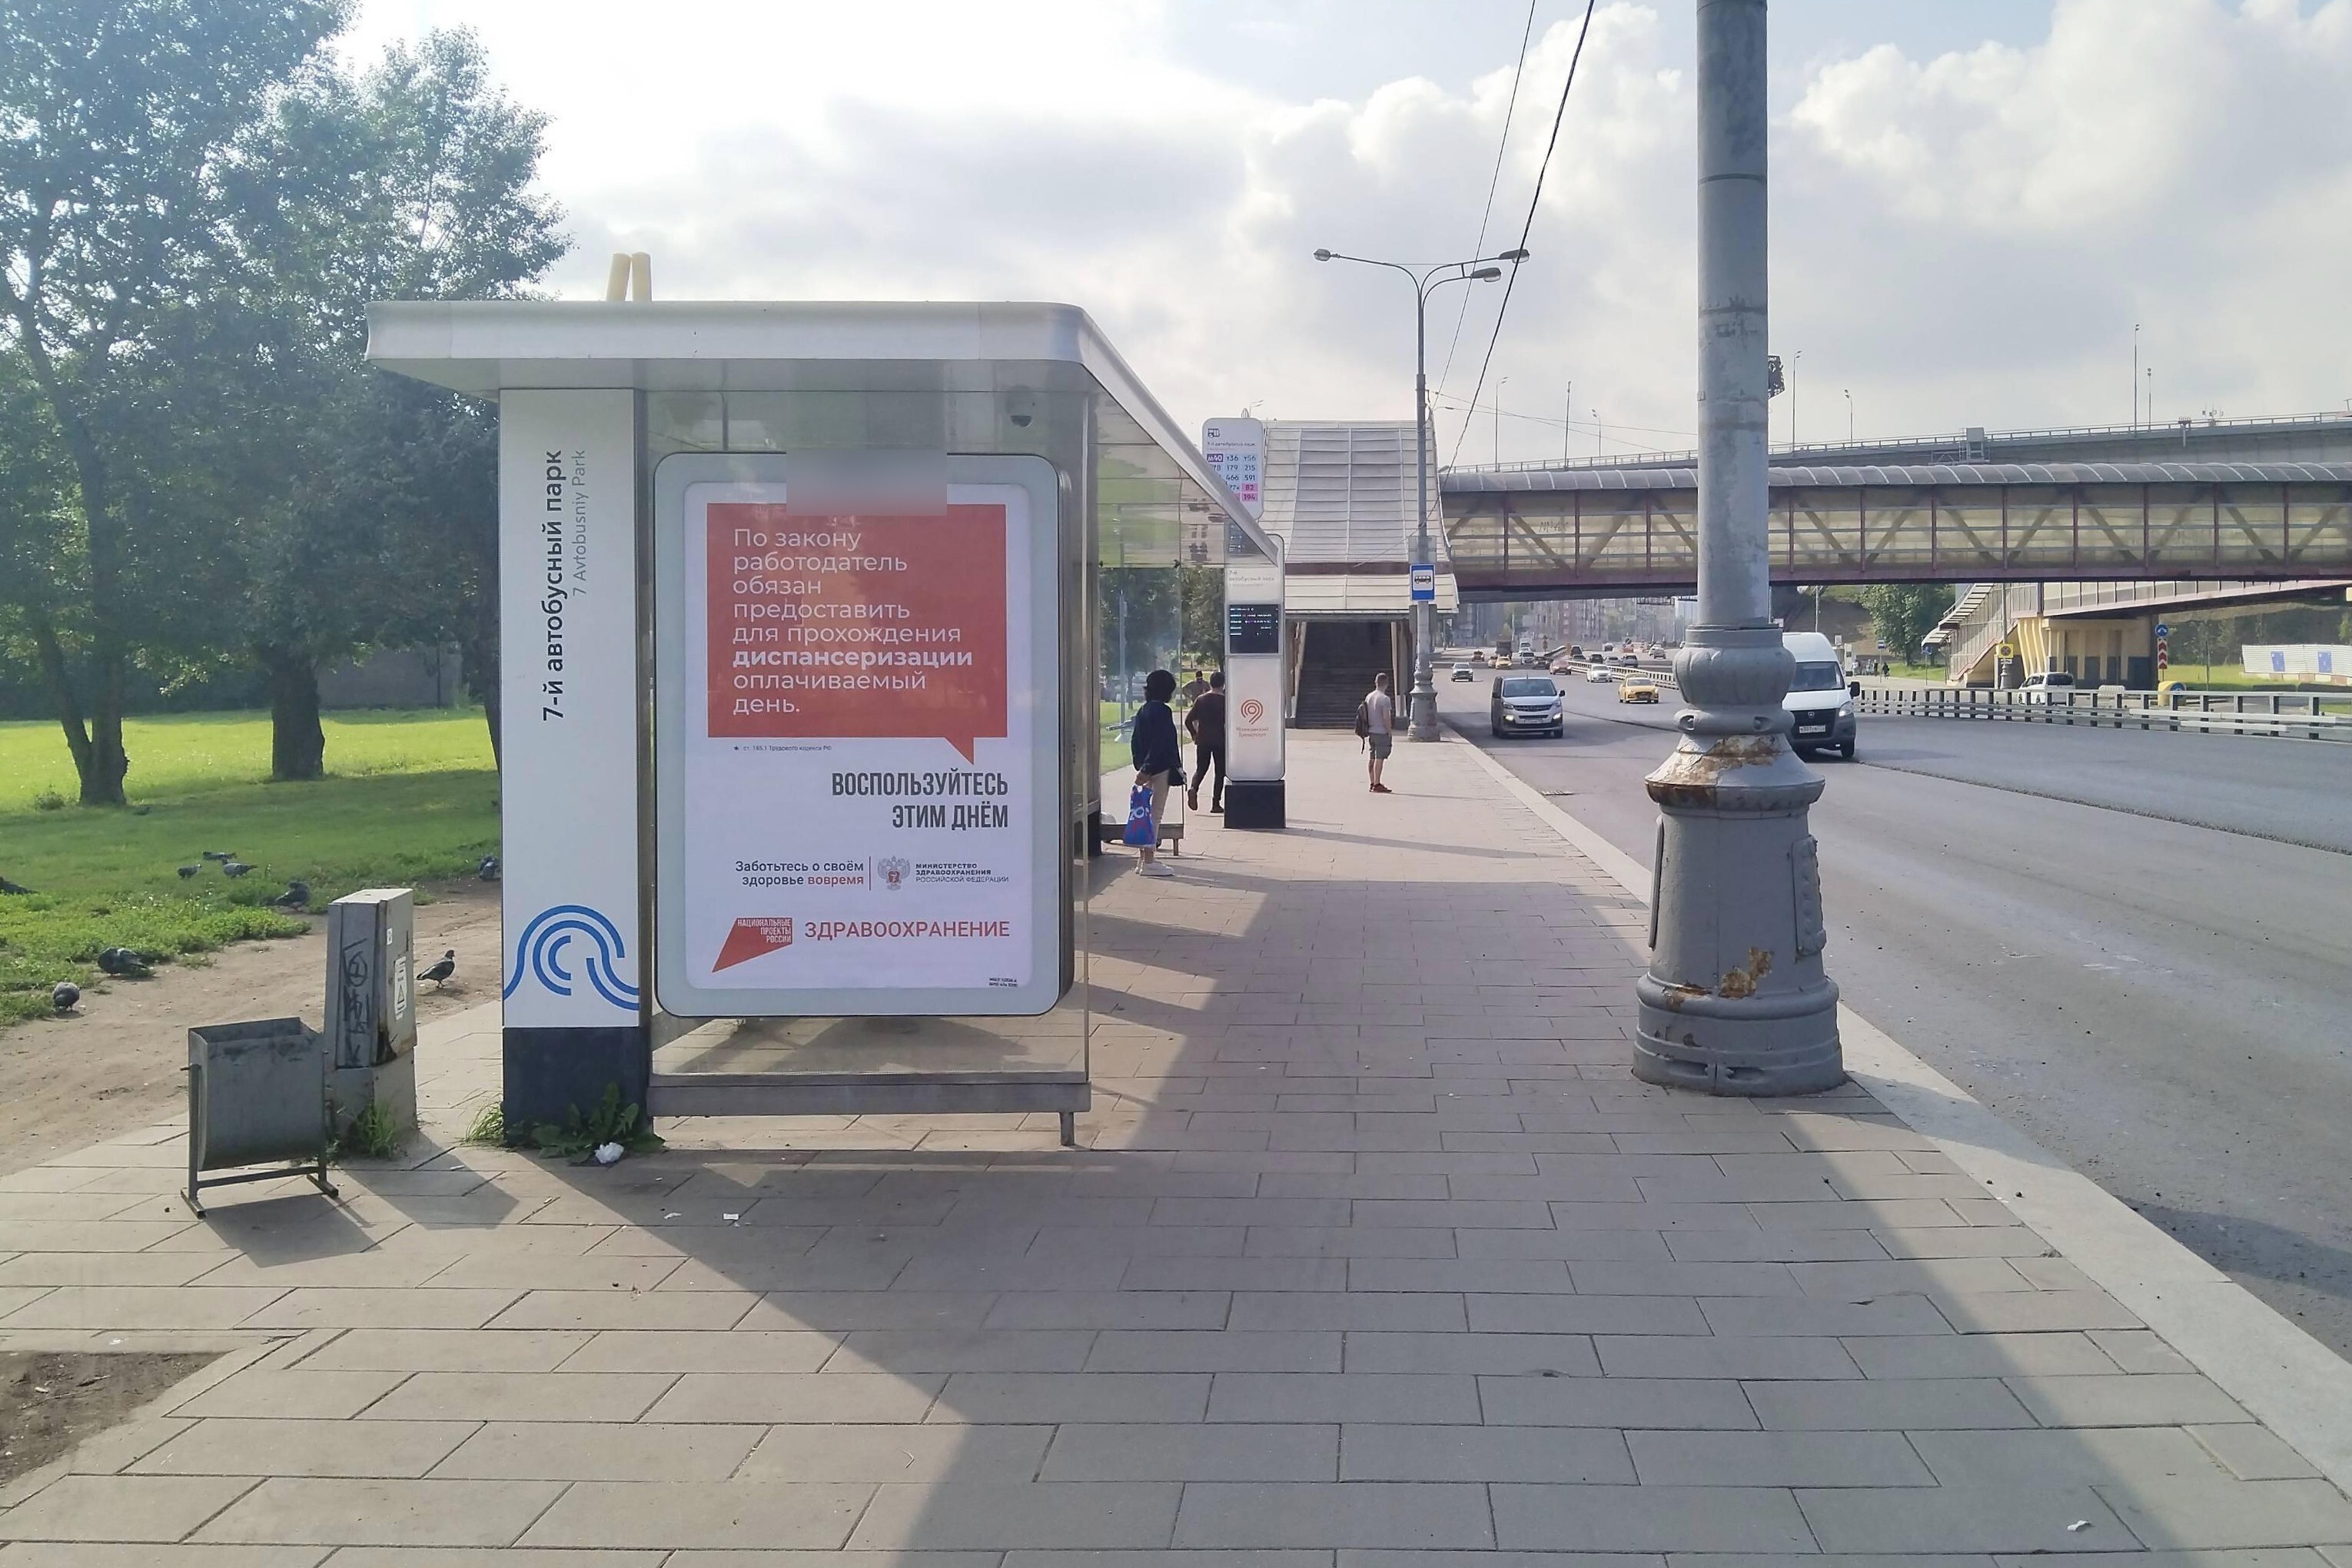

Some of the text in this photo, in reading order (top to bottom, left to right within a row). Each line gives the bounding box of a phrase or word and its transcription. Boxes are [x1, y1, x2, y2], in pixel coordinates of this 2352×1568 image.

[572, 450, 589, 596] 7 Avtobusniy Park
[734, 528, 862, 552] По закону
[734, 552, 908, 574] работодатель
[541, 450, 567, 721] 7-й автобусный парк
[733, 574, 822, 595] обязан
[734, 603, 910, 623] предоставить
[733, 626, 962, 646] для прохождения
[733, 650, 973, 669] диспансеризации
[733, 671, 926, 689] оплачиваемый
[733, 697, 801, 716] день.
[832, 767, 1008, 796] ВОСПОЛЬЗУЙТЕСЬ
[892, 800, 1008, 830] ЭТИМ ДНЁМ
[736, 861, 864, 872] Заботьтесь о своём
[742, 876, 864, 887] здоровье вовремя
[737, 919, 792, 927] НАЦИОНАЛЬНЫЕ
[805, 921, 1010, 939] ЗДРАВООХРАНЕНИЕ
